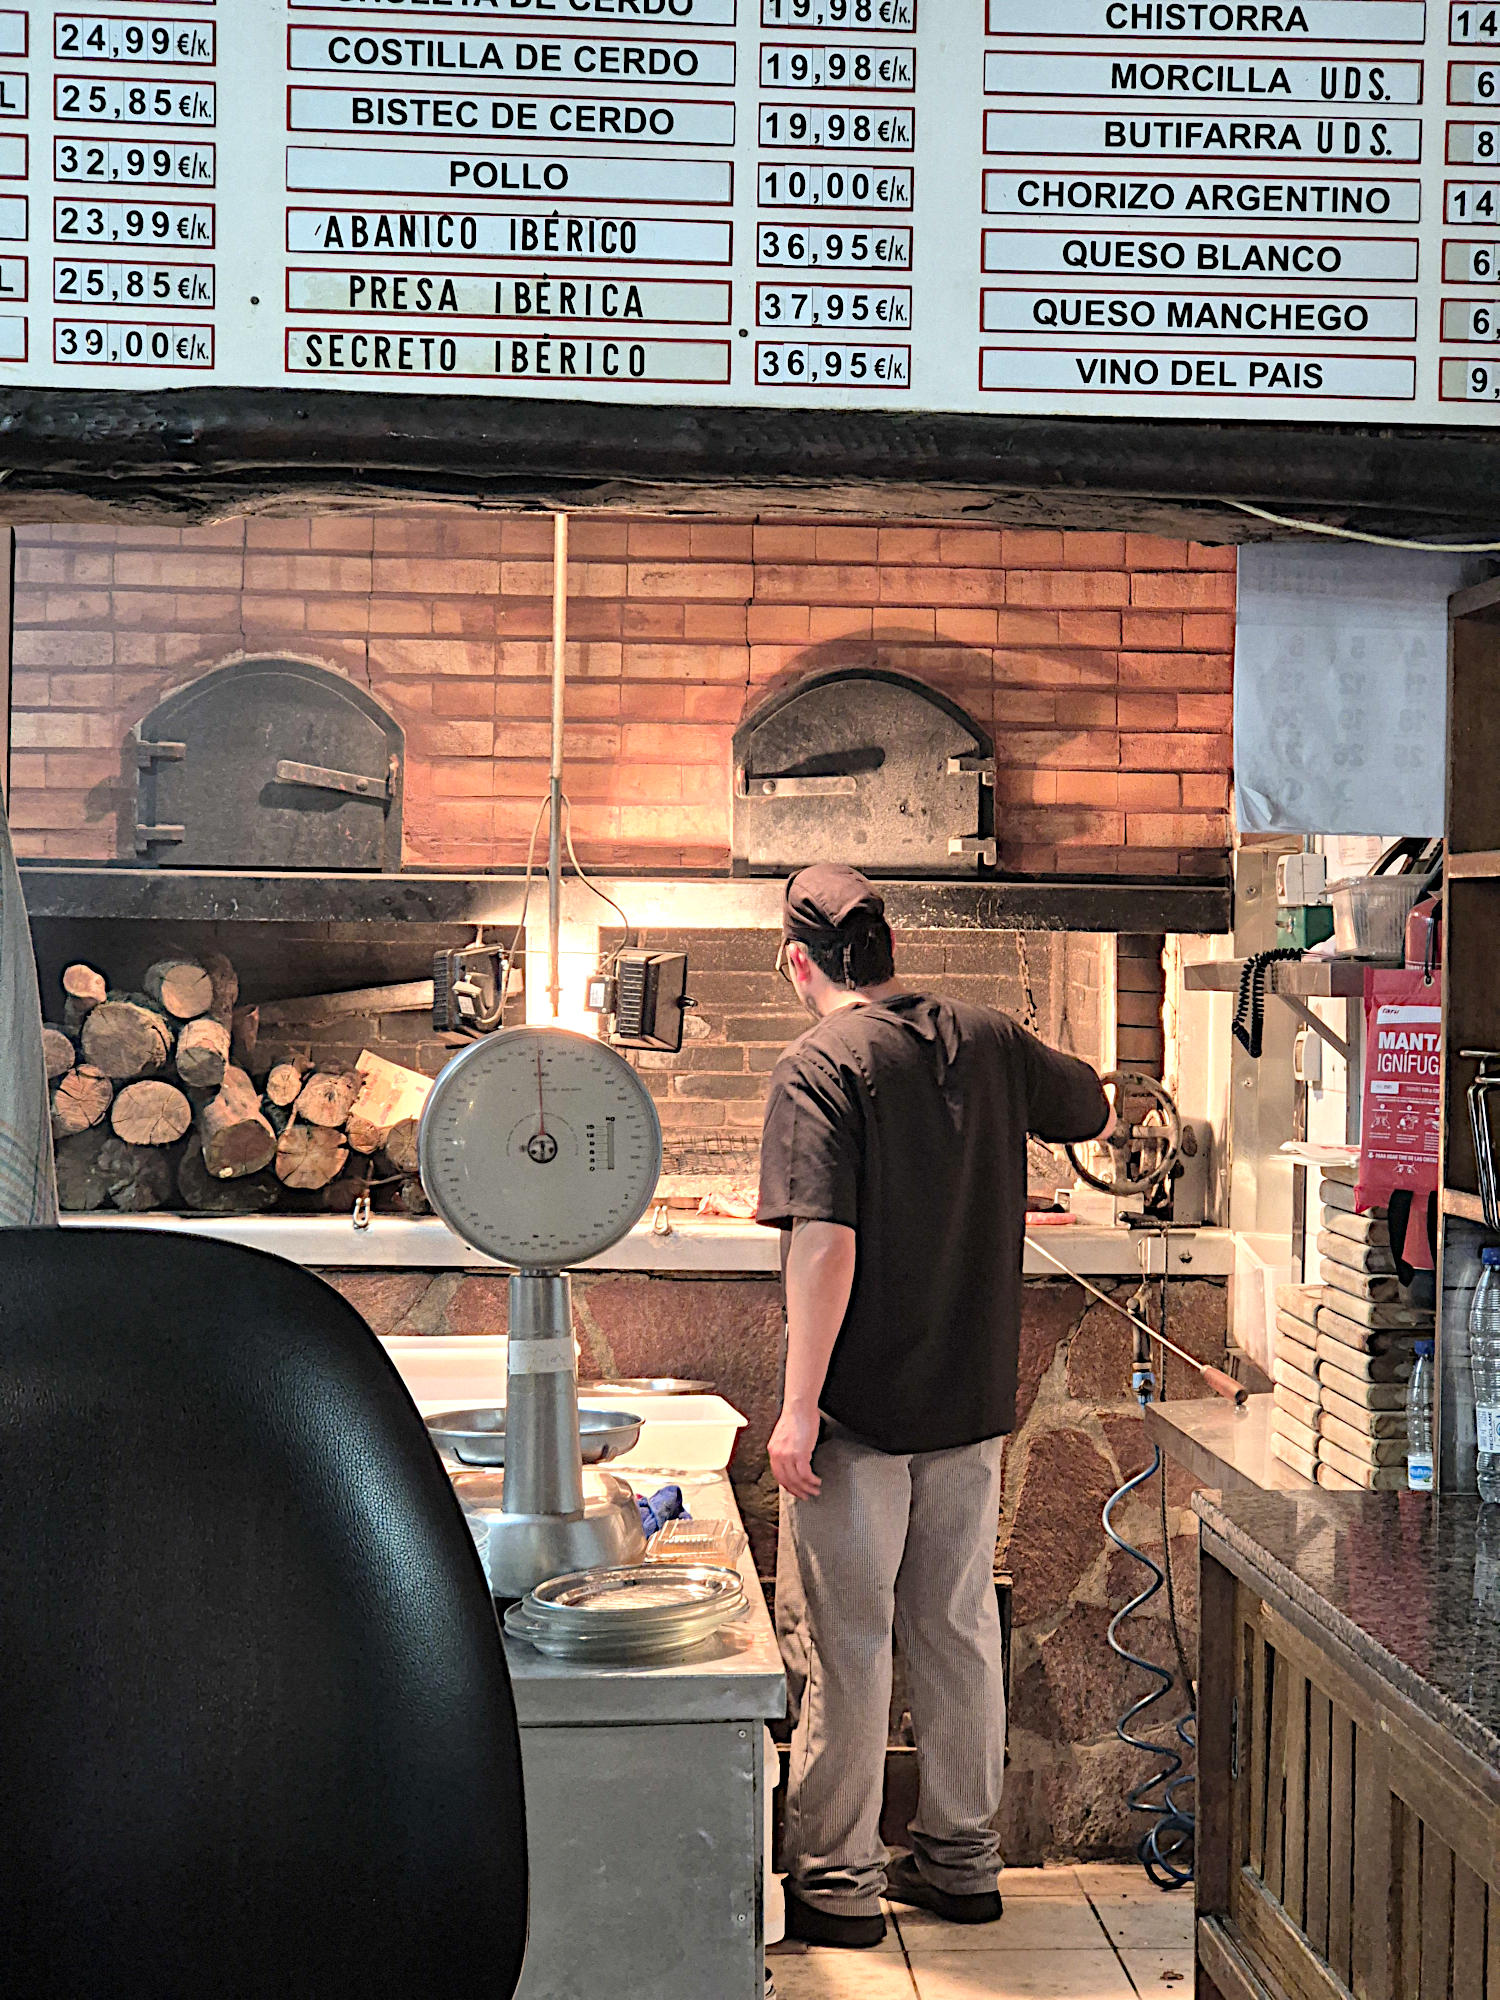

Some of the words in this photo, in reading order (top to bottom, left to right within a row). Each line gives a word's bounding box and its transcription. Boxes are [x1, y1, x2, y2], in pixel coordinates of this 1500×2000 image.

[1105, 2, 1309, 33] CHISTORRA
[328, 36, 504, 70] COSTILLA
[515, 43, 562, 72] DE
[573, 45, 699, 77] CERDO
[1111, 62, 1292, 94] MORCILLA
[352, 97, 478, 128] BISTEC
[491, 102, 538, 130] DE
[549, 104, 674, 135] CERDO
[1104, 121, 1302, 150] BUTIFARRA
[450, 160, 569, 190] POLLO
[1017, 180, 1175, 210] CHORIZO
[1184, 184, 1391, 214] ARGENTINO
[323, 214, 477, 250] ABANICO
[1062, 239, 1185, 269] QUESO
[1197, 243, 1342, 273] BLANCO
[349, 274, 459, 312] PRESA
[1032, 298, 1155, 328] QUESO
[1167, 301, 1369, 332] MANCHEGO
[305, 334, 456, 372] SECRETO
[1075, 358, 1159, 385] VINO
[1171, 360, 1237, 387] DEL
[1249, 361, 1323, 389] PAIS
[1377, 1050, 1441, 1075] IGNÍFUG
